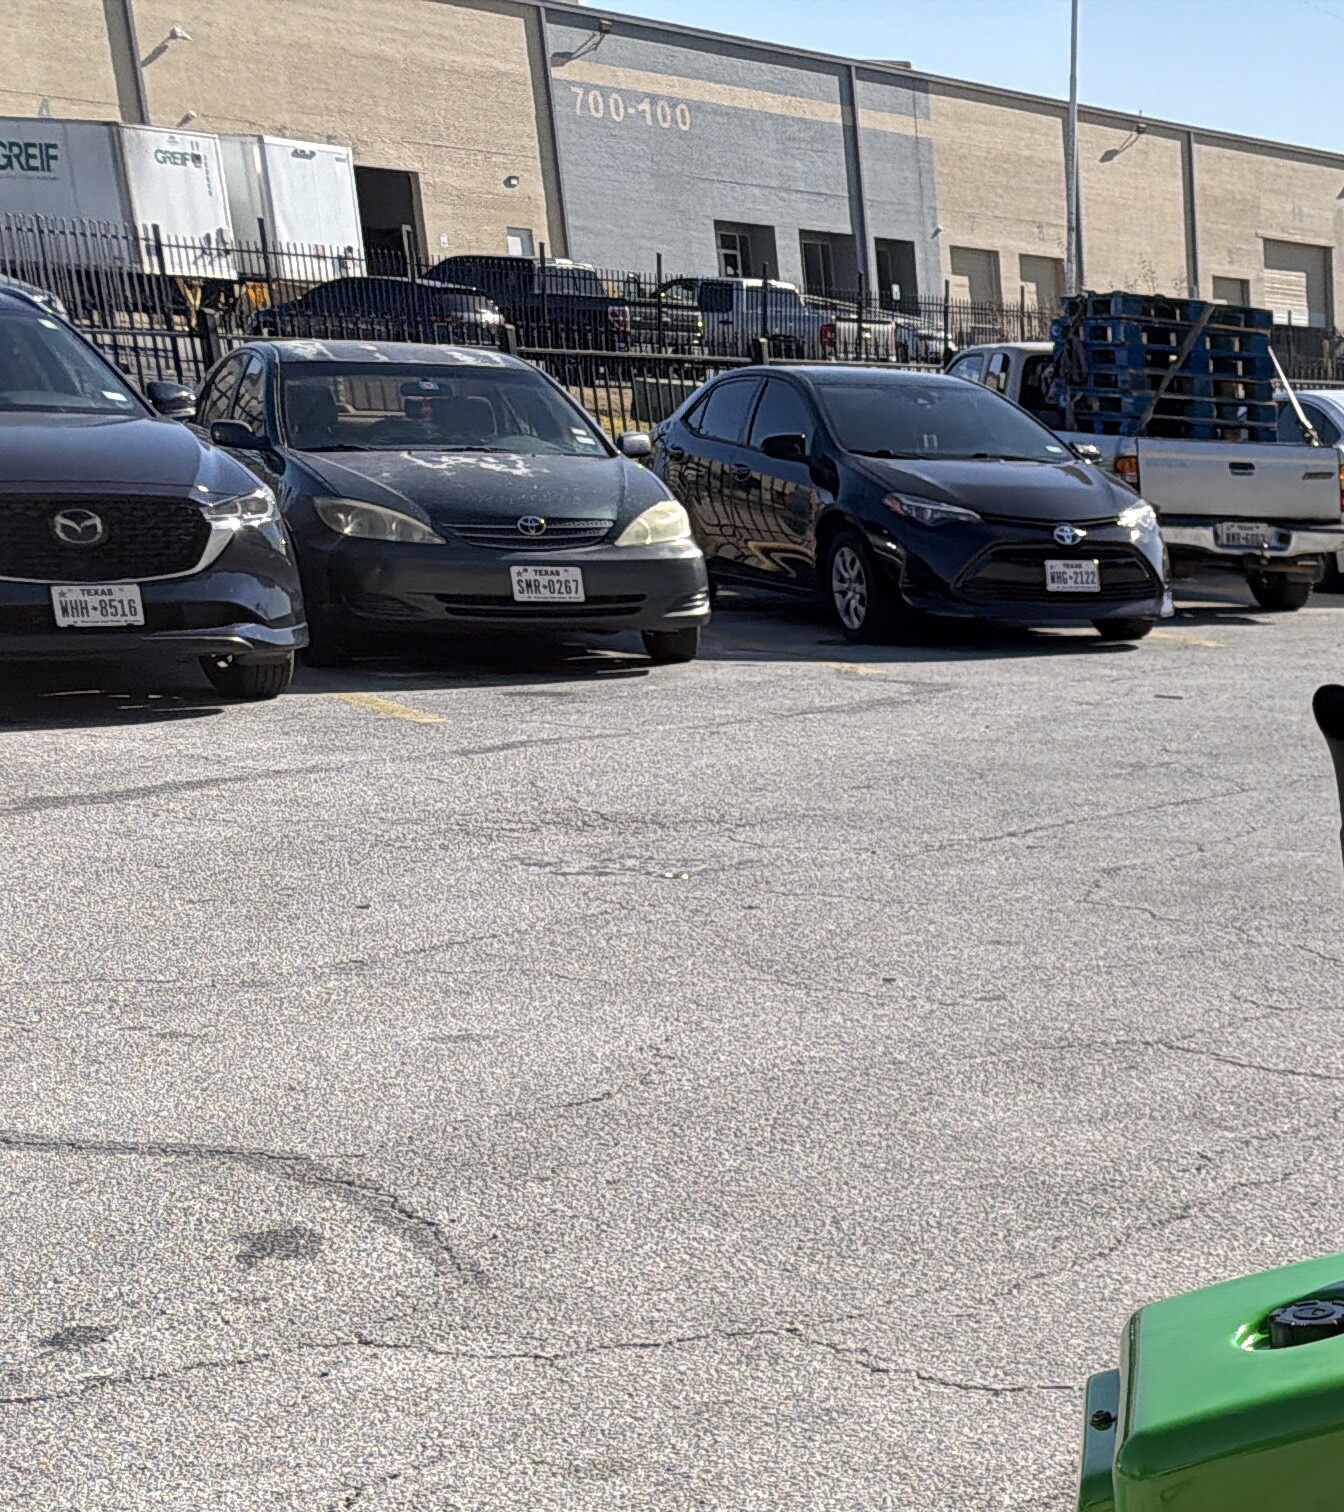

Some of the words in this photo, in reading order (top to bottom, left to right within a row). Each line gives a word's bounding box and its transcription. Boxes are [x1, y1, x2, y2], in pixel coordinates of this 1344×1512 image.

[570, 86, 691, 131] 700-100
[154, 149, 191, 167] GREIF
[533, 568, 561, 576] TEXAS
[79, 588, 113, 596] TEXAS
